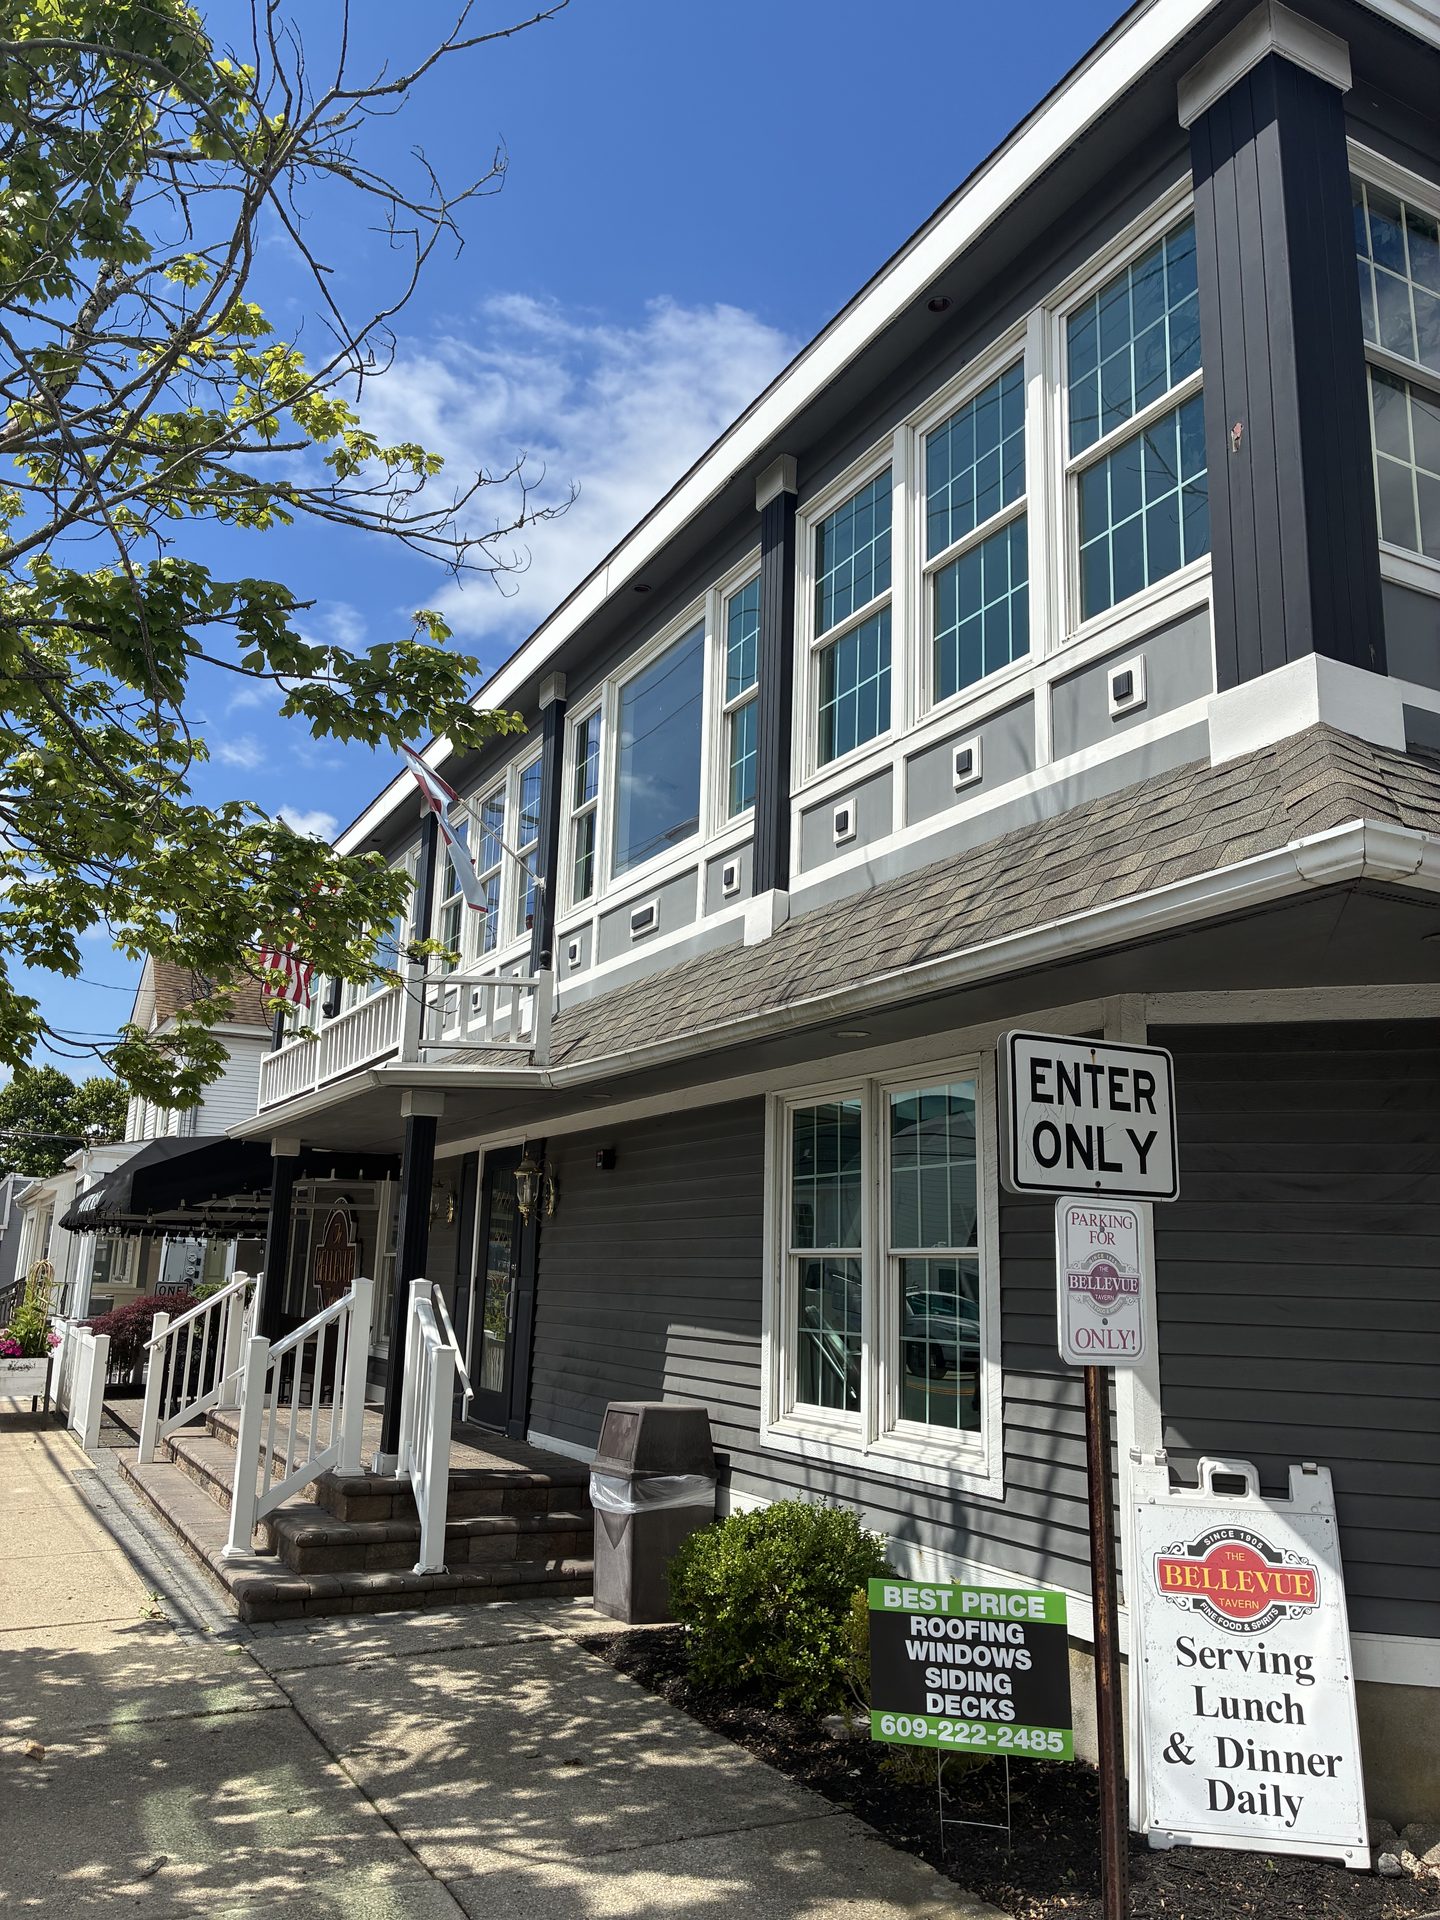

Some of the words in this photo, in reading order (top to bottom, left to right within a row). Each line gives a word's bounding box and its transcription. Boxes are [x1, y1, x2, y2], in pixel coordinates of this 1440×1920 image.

[1030, 1057, 1157, 1115] ENTER
[1032, 1120, 1158, 1175] ONLY
[1071, 1212, 1133, 1229] PARKING
[1089, 1230, 1116, 1245] FOR
[1069, 1274, 1139, 1292] BELLEVUE
[1099, 1265, 1109, 1273] THE
[1095, 1293, 1115, 1301] TAVERN
[1075, 1328, 1136, 1351] ONLY!
[1203, 1530, 1235, 1546] SINCE
[1240, 1533, 1263, 1549] 1905
[1225, 1551, 1245, 1561] THE
[1163, 1564, 1313, 1597] BELLEVUE
[883, 1586, 953, 1612] BEST
[962, 1591, 1046, 1619] PRICE
[1200, 1601, 1218, 1620] FINE
[1217, 1615, 1243, 1631] FOOD
[1244, 1623, 1251, 1631] &
[1251, 1607, 1279, 1630] SPIRITS
[1218, 1597, 1259, 1609] TAVERN
[910, 1615, 1025, 1645] ROOFING
[905, 1639, 1032, 1671] WINDOWS
[1176, 1635, 1316, 1686] Serving
[925, 1667, 1012, 1695] SIDING
[926, 1692, 1016, 1721] DECKS
[1190, 1685, 1306, 1726] Lunch
[880, 1715, 1064, 1753] 609-222-2485
[1162, 1732, 1196, 1766] &
[1214, 1734, 1343, 1779] Dinner
[1204, 1777, 1305, 1828] Daily
